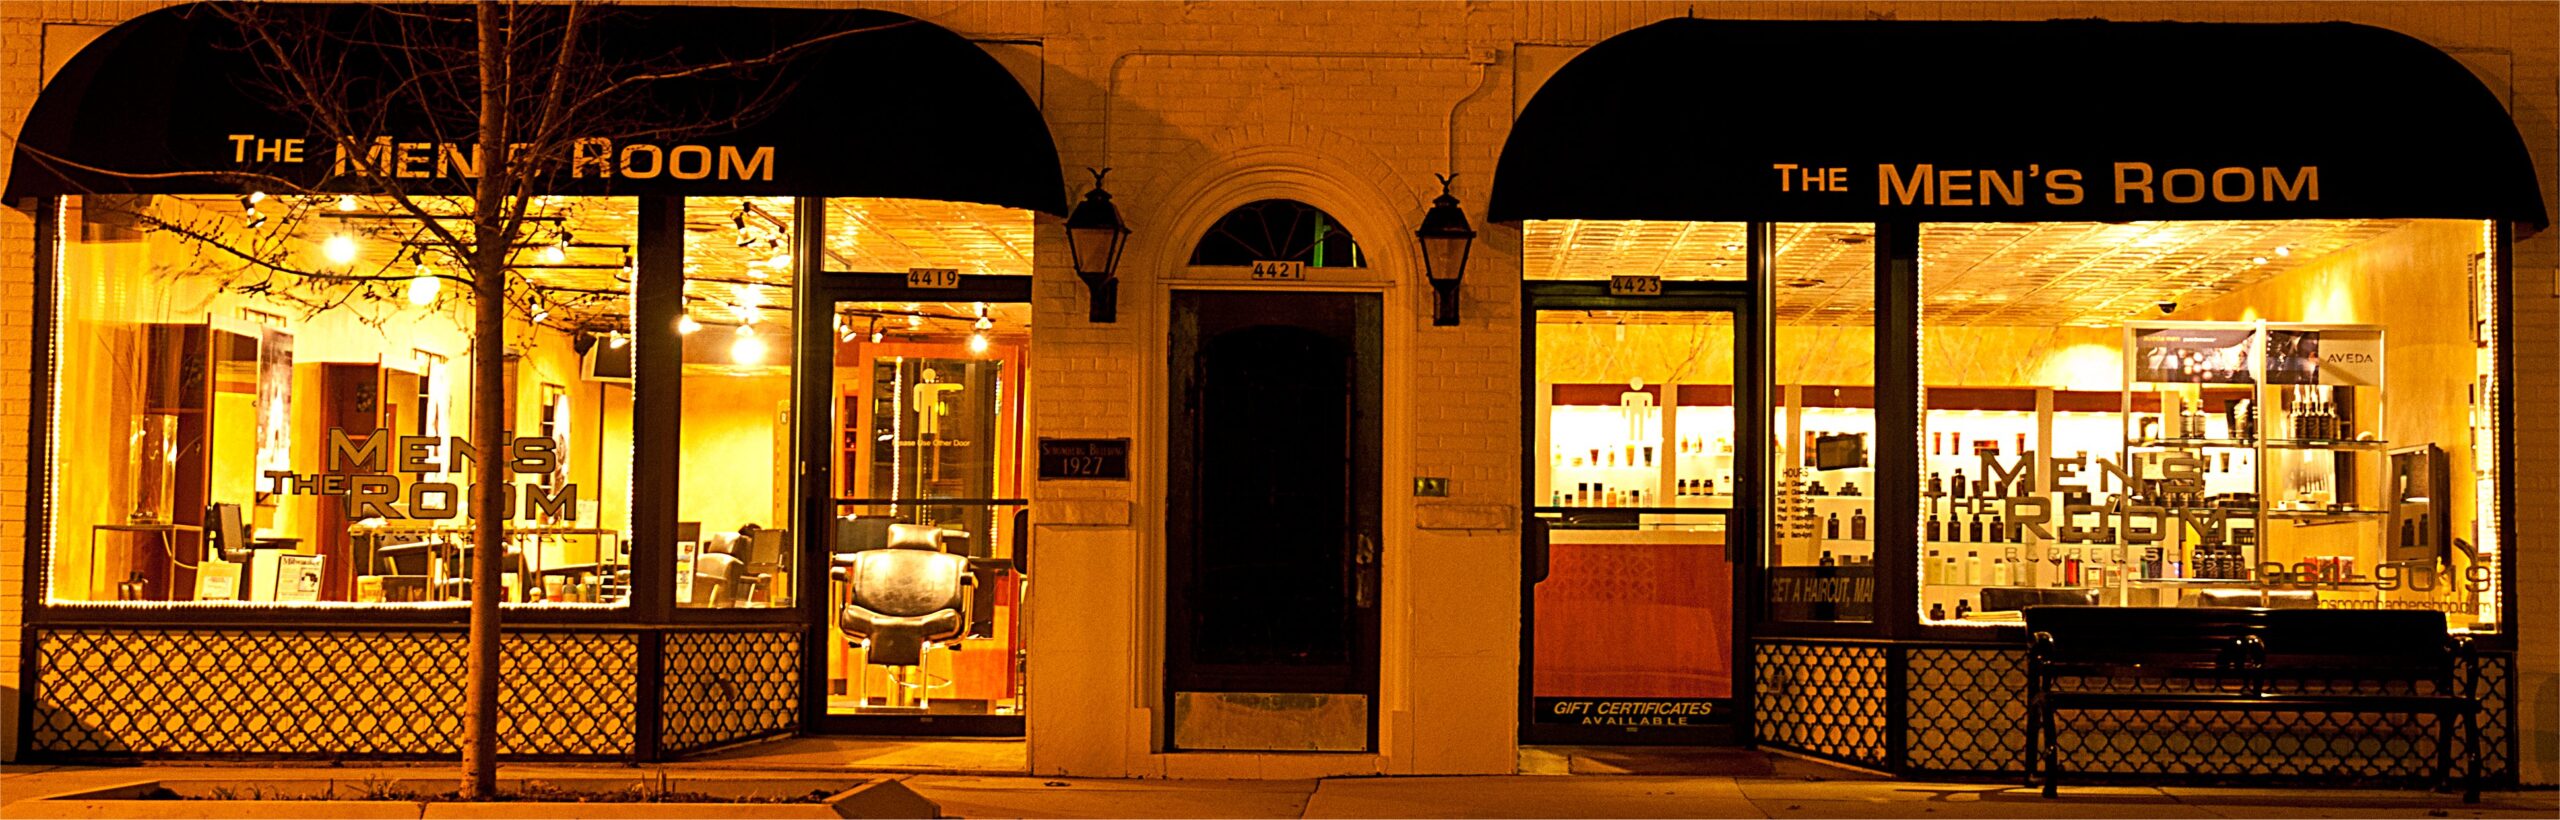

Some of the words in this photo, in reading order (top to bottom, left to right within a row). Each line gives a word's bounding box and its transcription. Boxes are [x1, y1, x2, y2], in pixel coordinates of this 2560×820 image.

[572, 136, 775, 181] ROOM
[1773, 163, 1847, 192] THE
[2114, 161, 2318, 204] ROOM
[908, 269, 956, 287] 4419
[1254, 262, 1301, 279] 4421
[1612, 277, 1658, 292] 4423
[2326, 353, 2374, 363] AVEDA
[953, 439, 970, 447] Door
[1063, 457, 1103, 475] 1927
[349, 474, 577, 520] ROOM
[2005, 496, 2227, 541] ROOM
[2257, 560, 2491, 593] 964-9019
[1793, 578, 1801, 602] A
[1553, 702, 1593, 715] GIFT
[1597, 702, 1712, 715] CERTIFICATES
[1582, 717, 1688, 725] AVAILABLE
